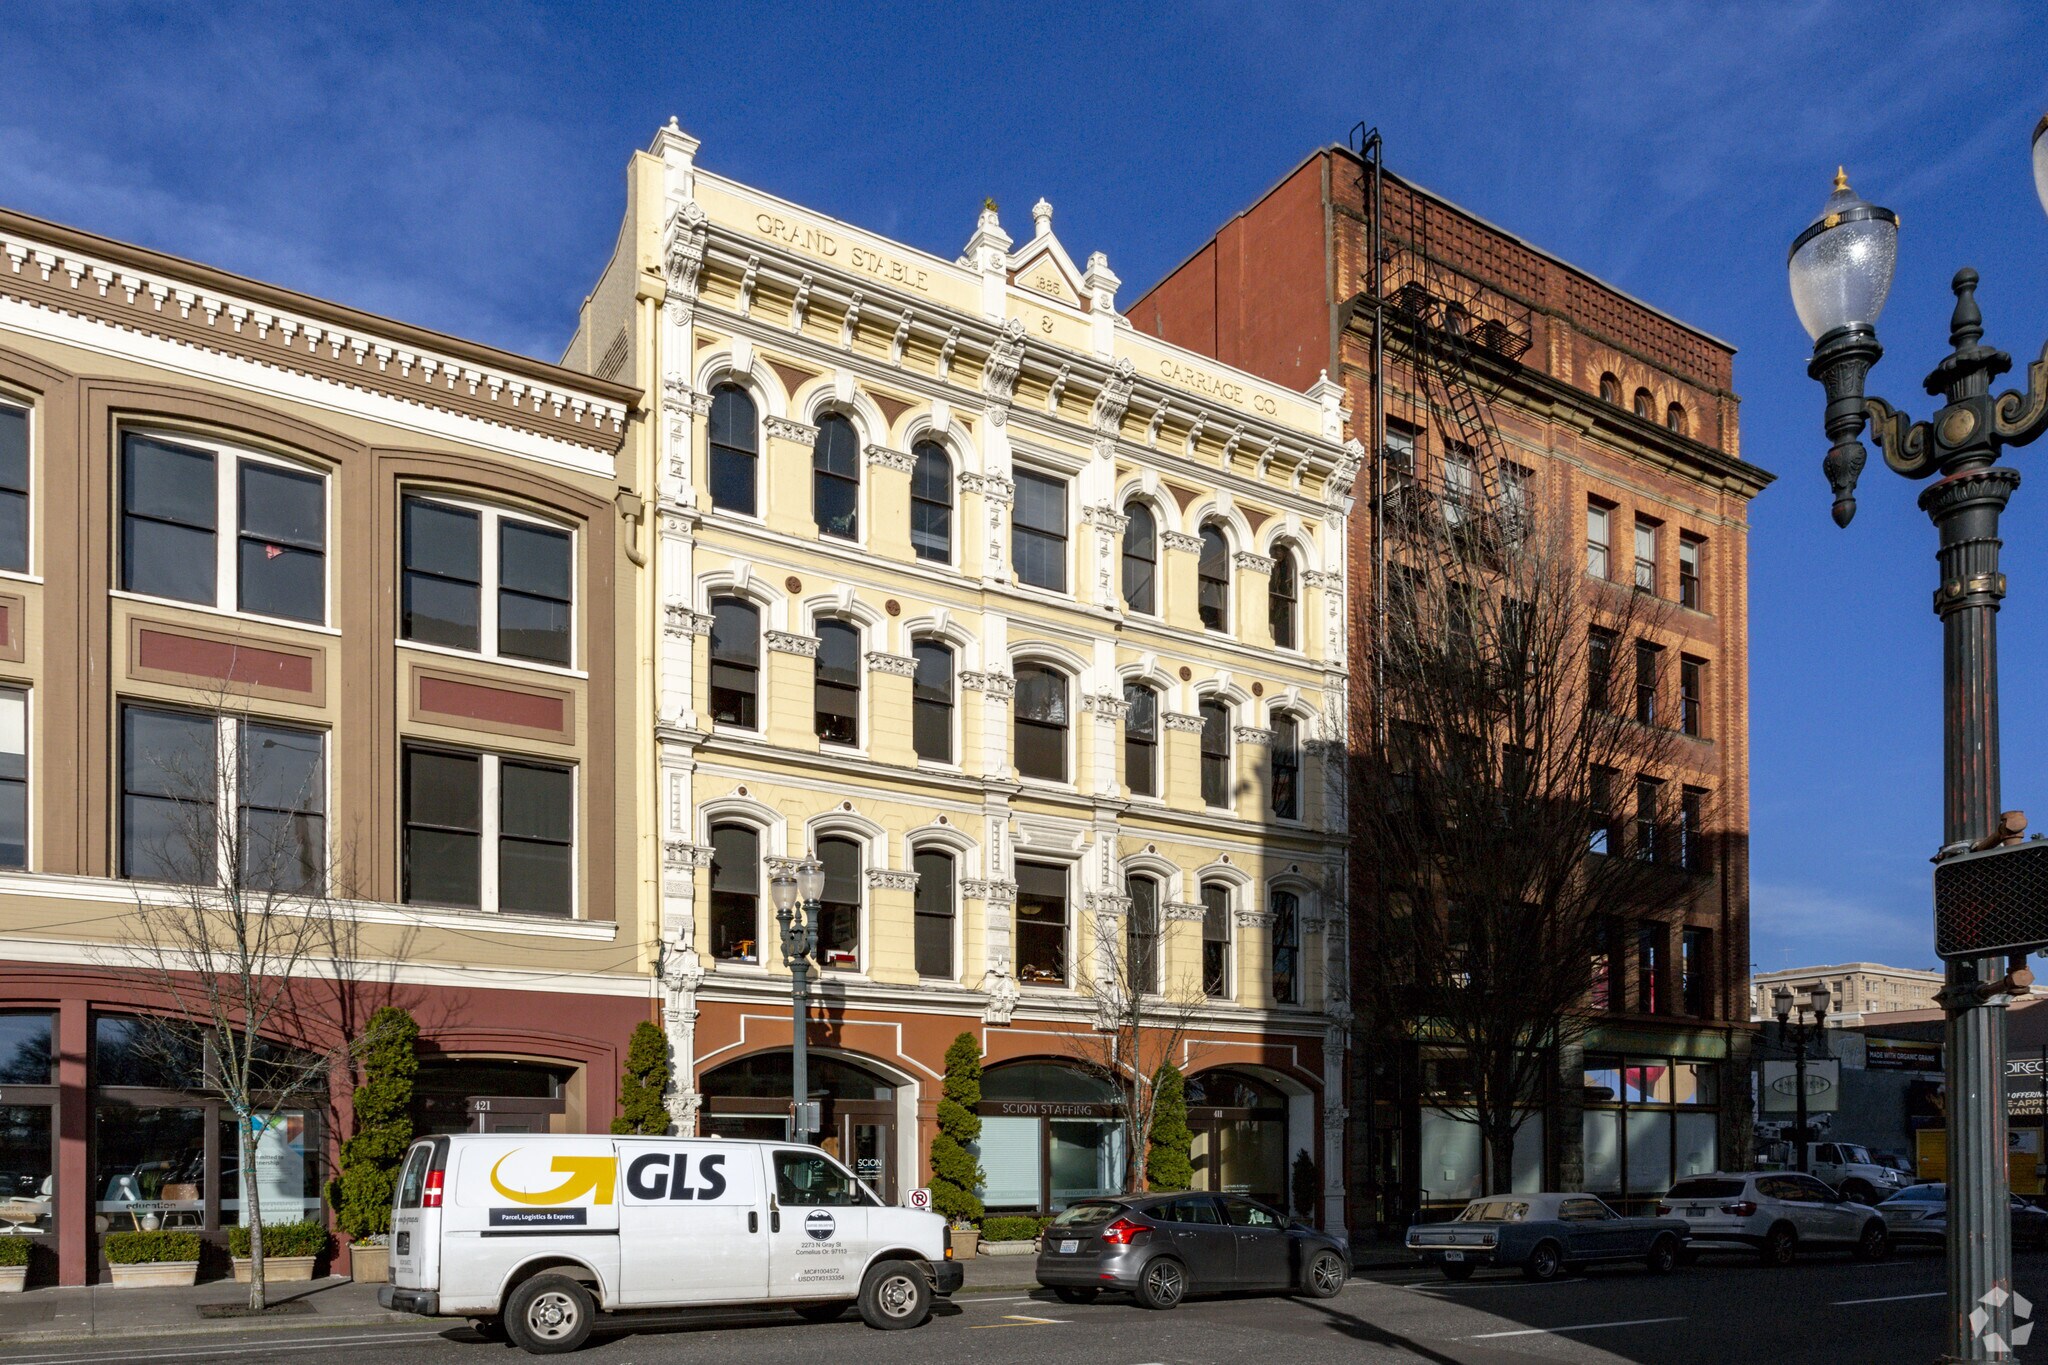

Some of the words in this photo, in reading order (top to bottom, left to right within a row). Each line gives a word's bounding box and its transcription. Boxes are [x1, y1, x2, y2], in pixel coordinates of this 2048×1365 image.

[756, 213, 838, 257] GRAND
[851, 247, 929, 291] STABLE
[1160, 360, 1244, 404] CARRIAGE
[2006, 1060, 2048, 1074] DIREC
[474, 1100, 491, 1111] 421
[1002, 1103, 1037, 1114] SCION
[1041, 1104, 1092, 1116] STAFFING
[1213, 1110, 1223, 1118] 411
[857, 1158, 882, 1167] SCION
[626, 1152, 727, 1201] GLS
[522, 1213, 546, 1222] Logistics
[553, 1213, 575, 1221] Express
[821, 1241, 835, 1249] Gray
